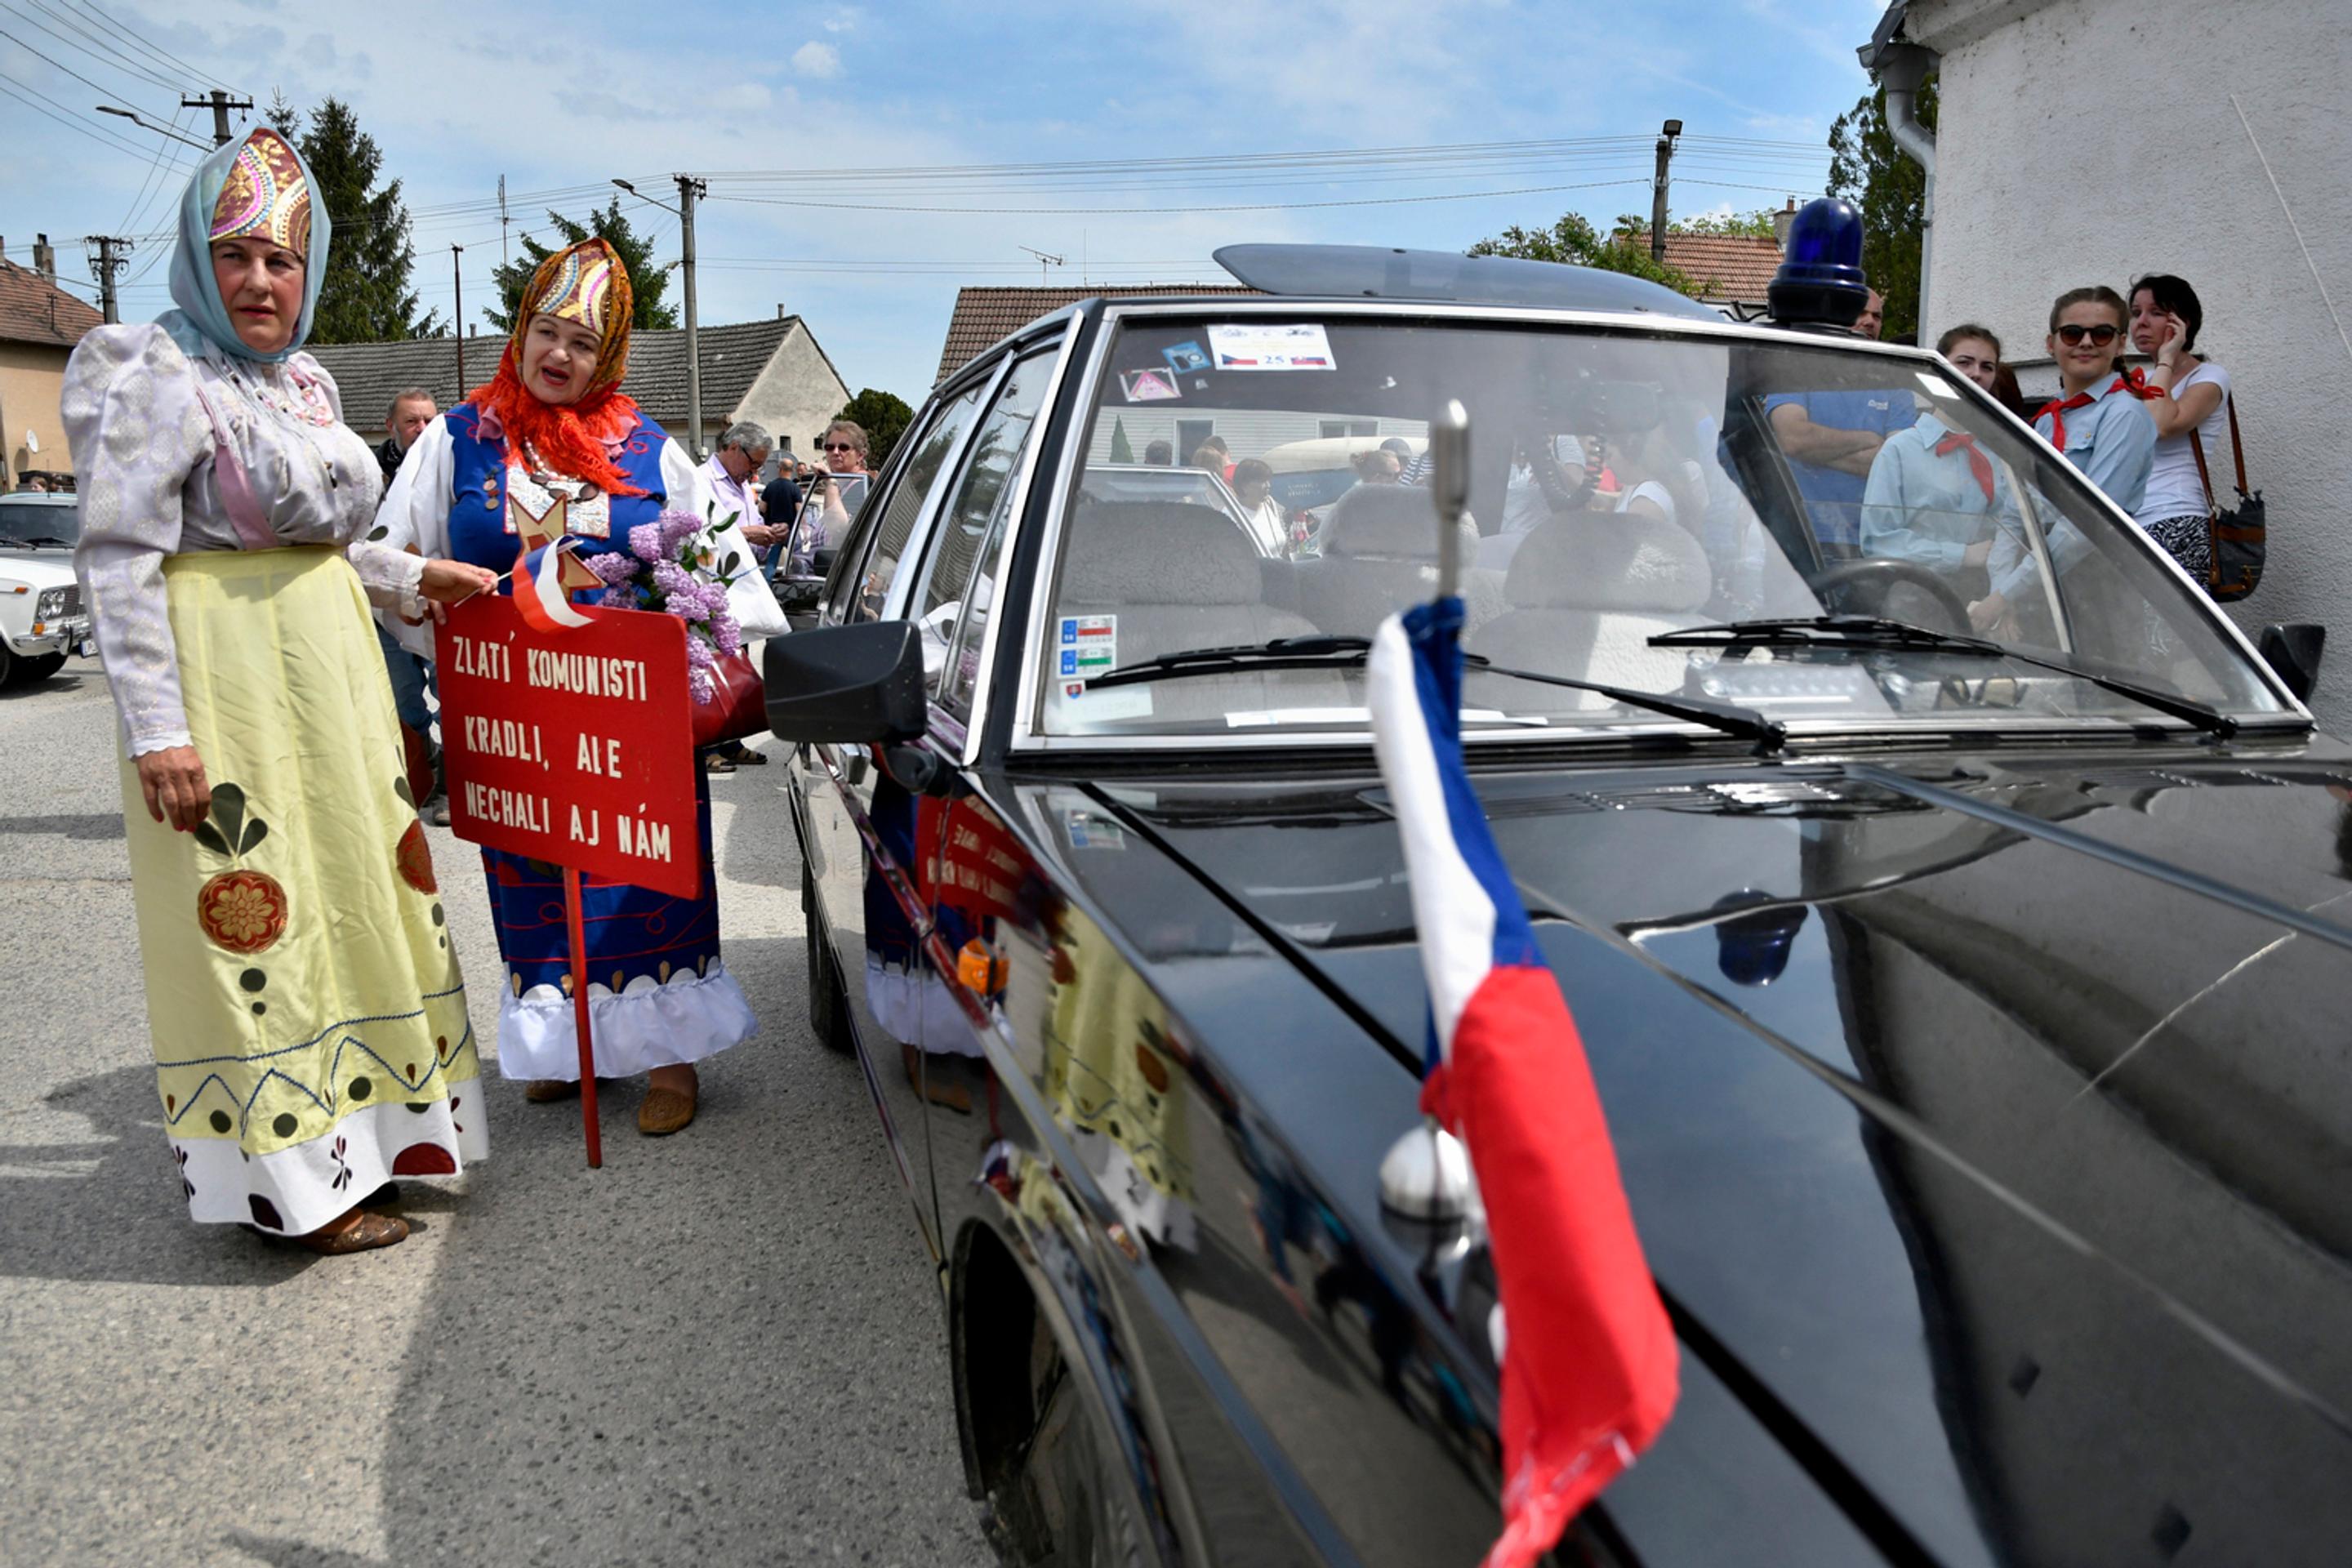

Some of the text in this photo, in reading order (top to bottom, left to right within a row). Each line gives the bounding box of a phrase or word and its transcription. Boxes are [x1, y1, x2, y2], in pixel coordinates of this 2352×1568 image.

[1264, 354, 1285, 365] 25
[452, 630, 648, 702] ZLATÍ KOMUNISTI
[465, 715, 622, 779] KRADLI, ALE
[465, 781, 672, 863] NECHALI AJ NÁM
